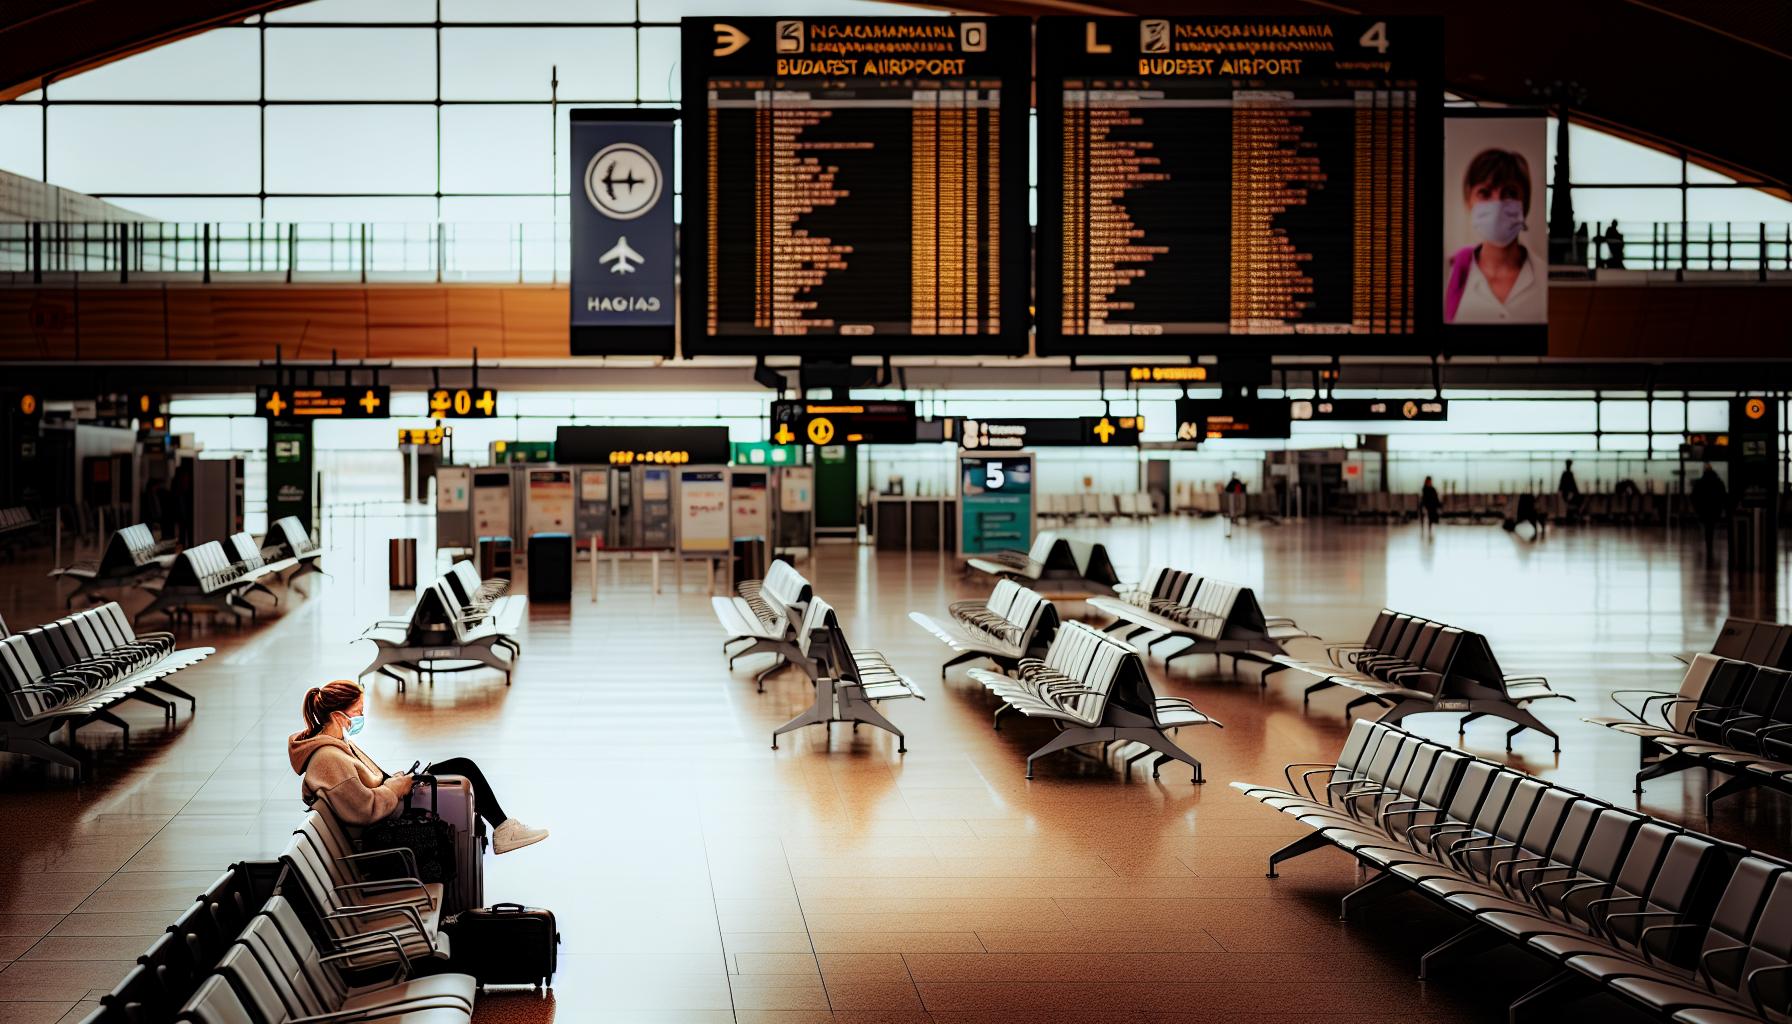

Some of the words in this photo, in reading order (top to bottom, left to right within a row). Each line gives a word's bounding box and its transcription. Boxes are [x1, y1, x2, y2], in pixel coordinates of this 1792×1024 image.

[1087, 22, 1111, 53] L
[1360, 22, 1388, 53] 4
[1220, 59, 1301, 74] AIRPORT
[986, 462, 1004, 489] 5
